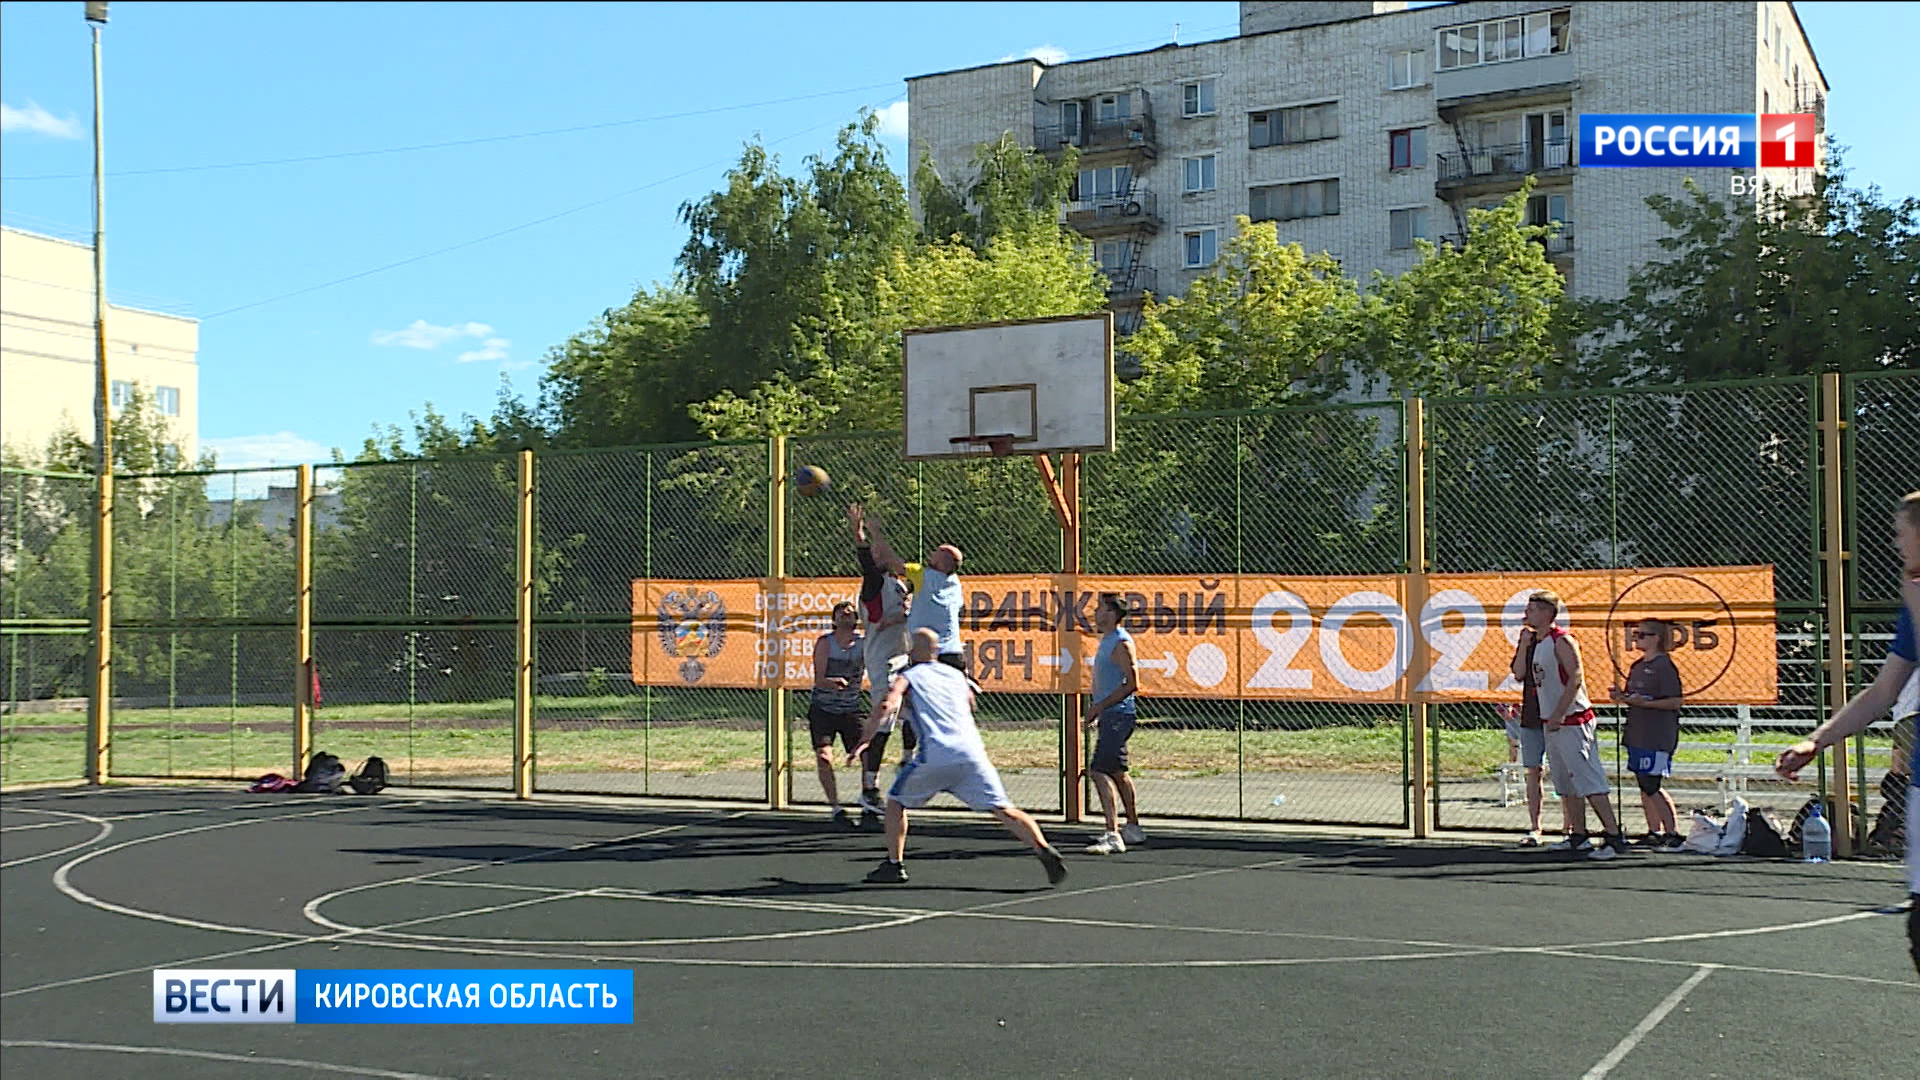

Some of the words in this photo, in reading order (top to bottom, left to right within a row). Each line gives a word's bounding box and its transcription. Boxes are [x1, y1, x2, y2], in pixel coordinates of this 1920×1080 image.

[755, 592, 860, 610] ВСЕРОССИ
[959, 579, 1227, 635] РАНЖВЫЙ
[754, 638, 815, 656] СОРЕВ
